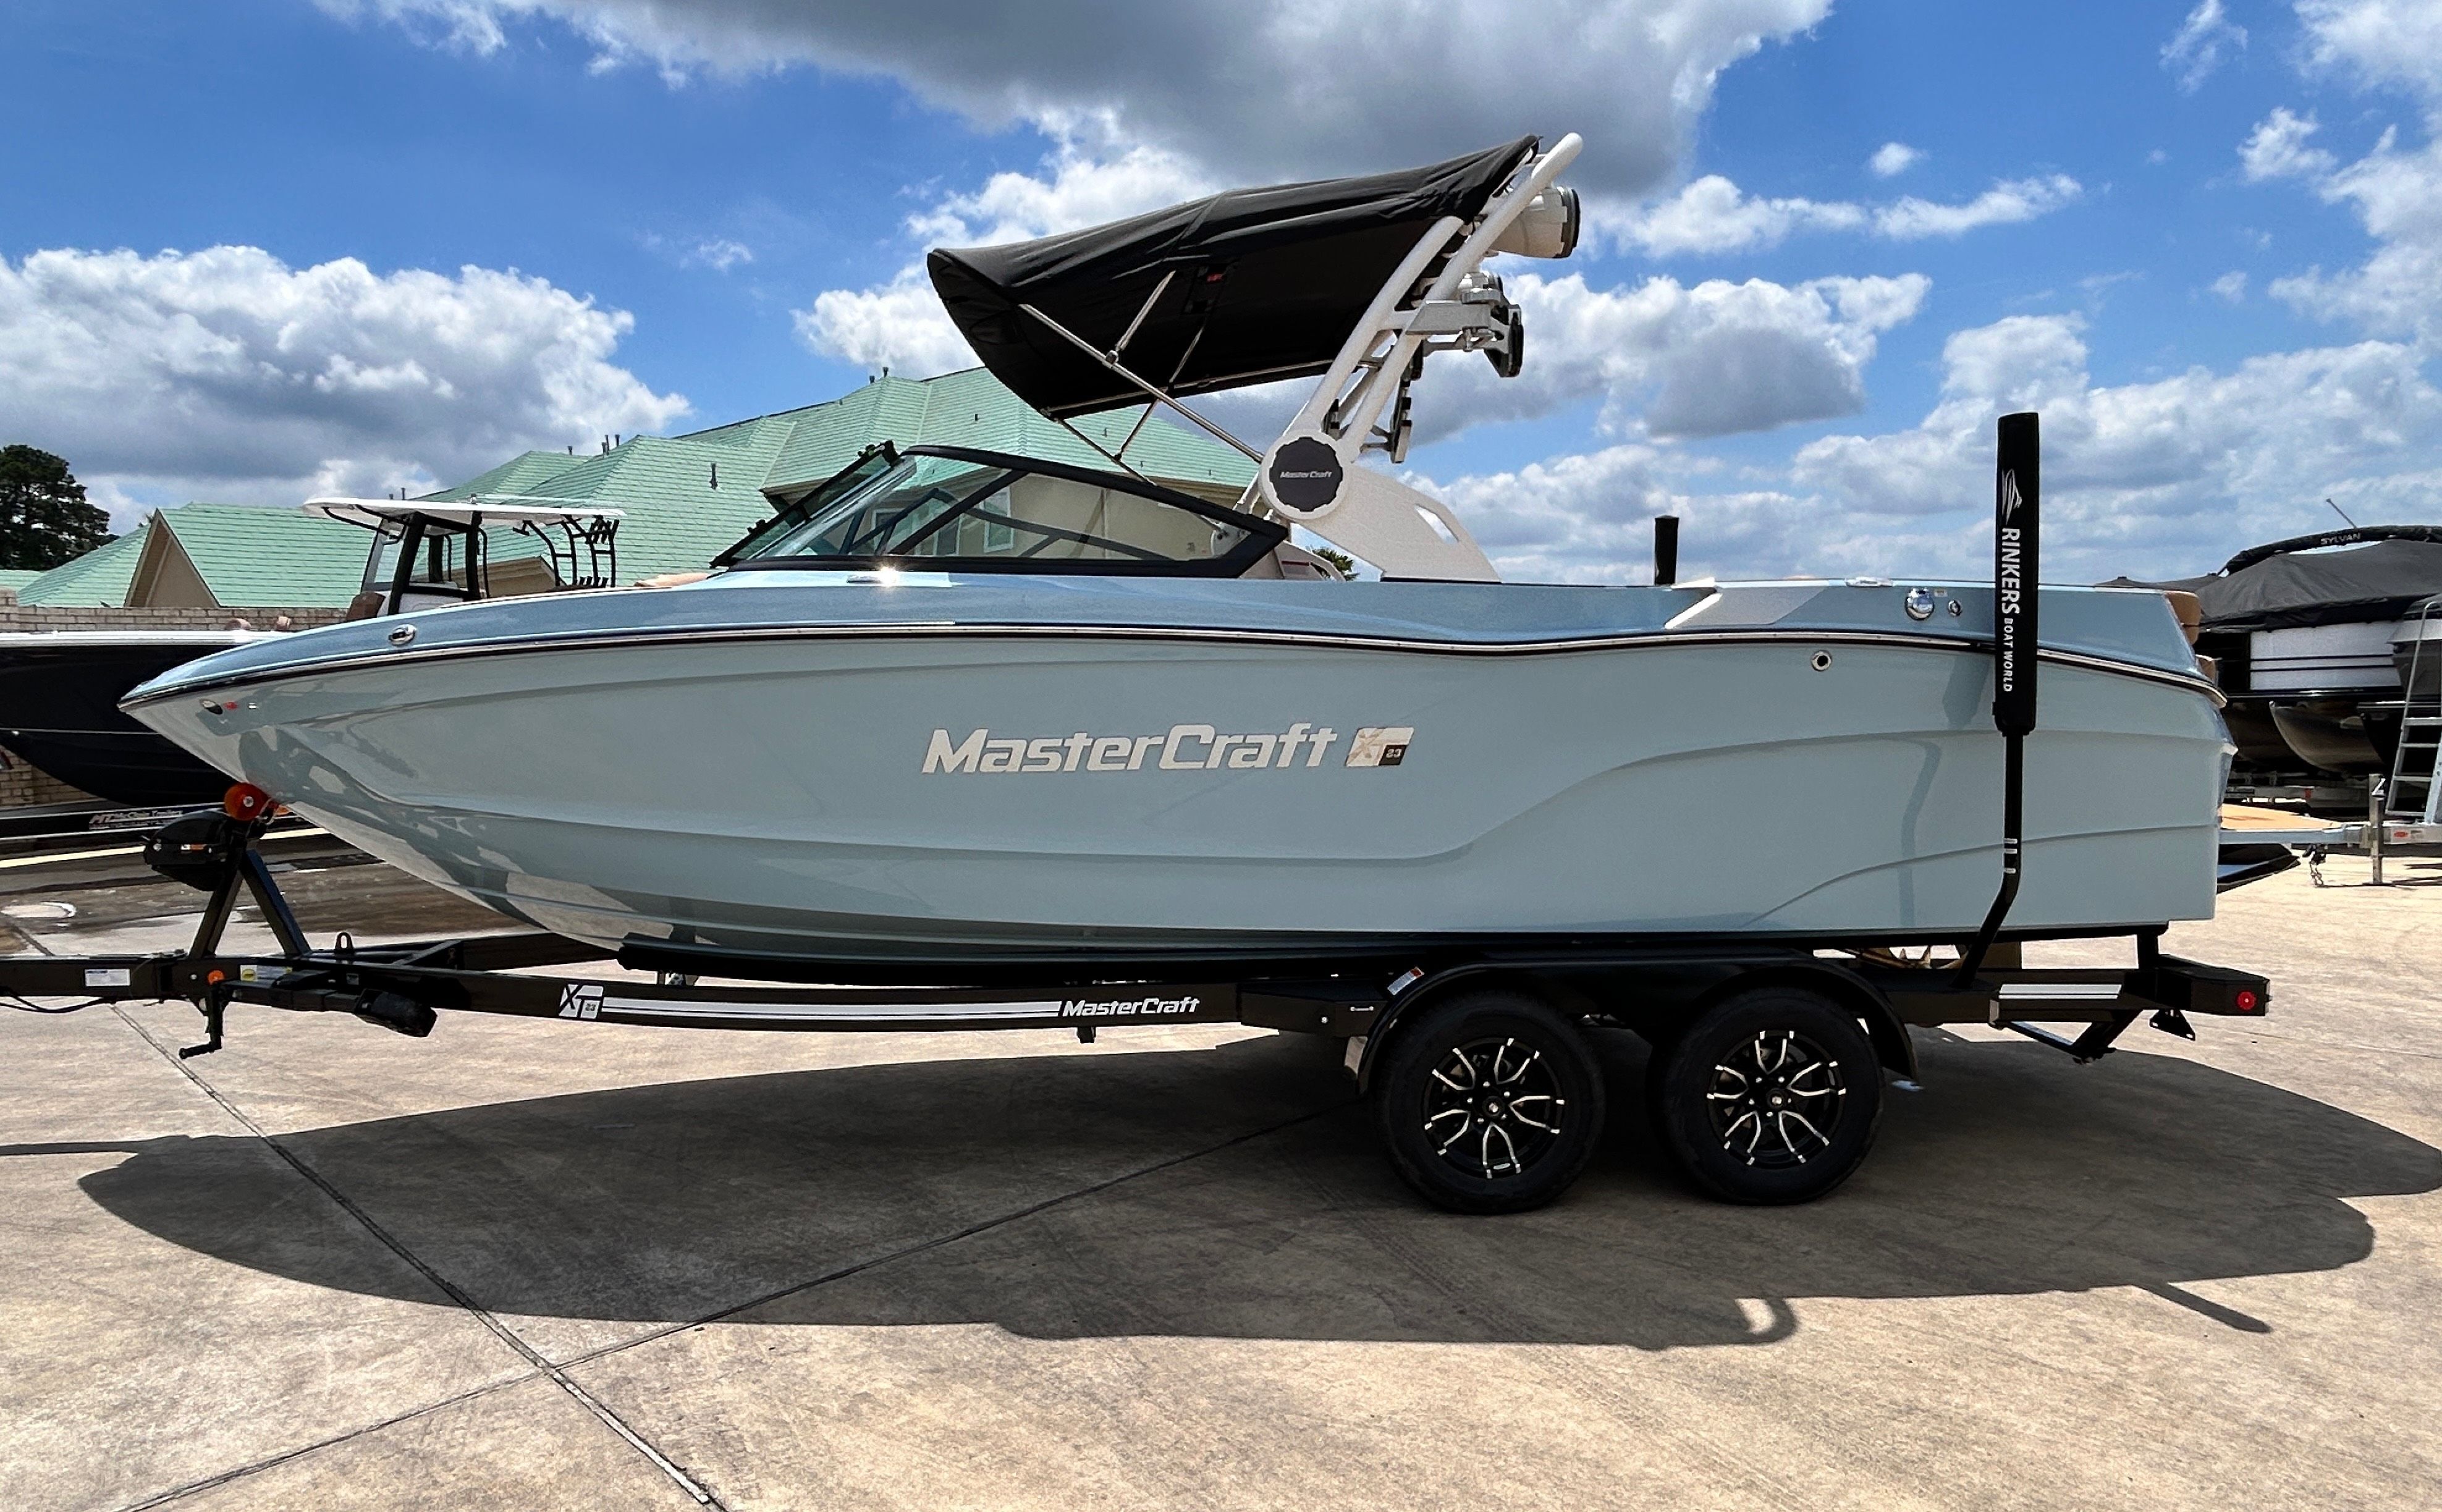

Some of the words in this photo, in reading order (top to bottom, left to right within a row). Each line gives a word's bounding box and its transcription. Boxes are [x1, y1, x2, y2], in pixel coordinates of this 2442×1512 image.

[1280, 471, 1333, 479] MasterCraft
[2320, 532, 2361, 544] SYLVAN
[2001, 528, 2021, 615] RINKERS
[2003, 618, 2014, 648] BOAT
[2003, 651, 2014, 692] WORLD
[921, 722, 1337, 774] MasterCraft
[1386, 748, 1402, 758] 23
[559, 983, 602, 1018] XT
[585, 1003, 596, 1012] 23
[1062, 997, 1200, 1017] MasterCraft
